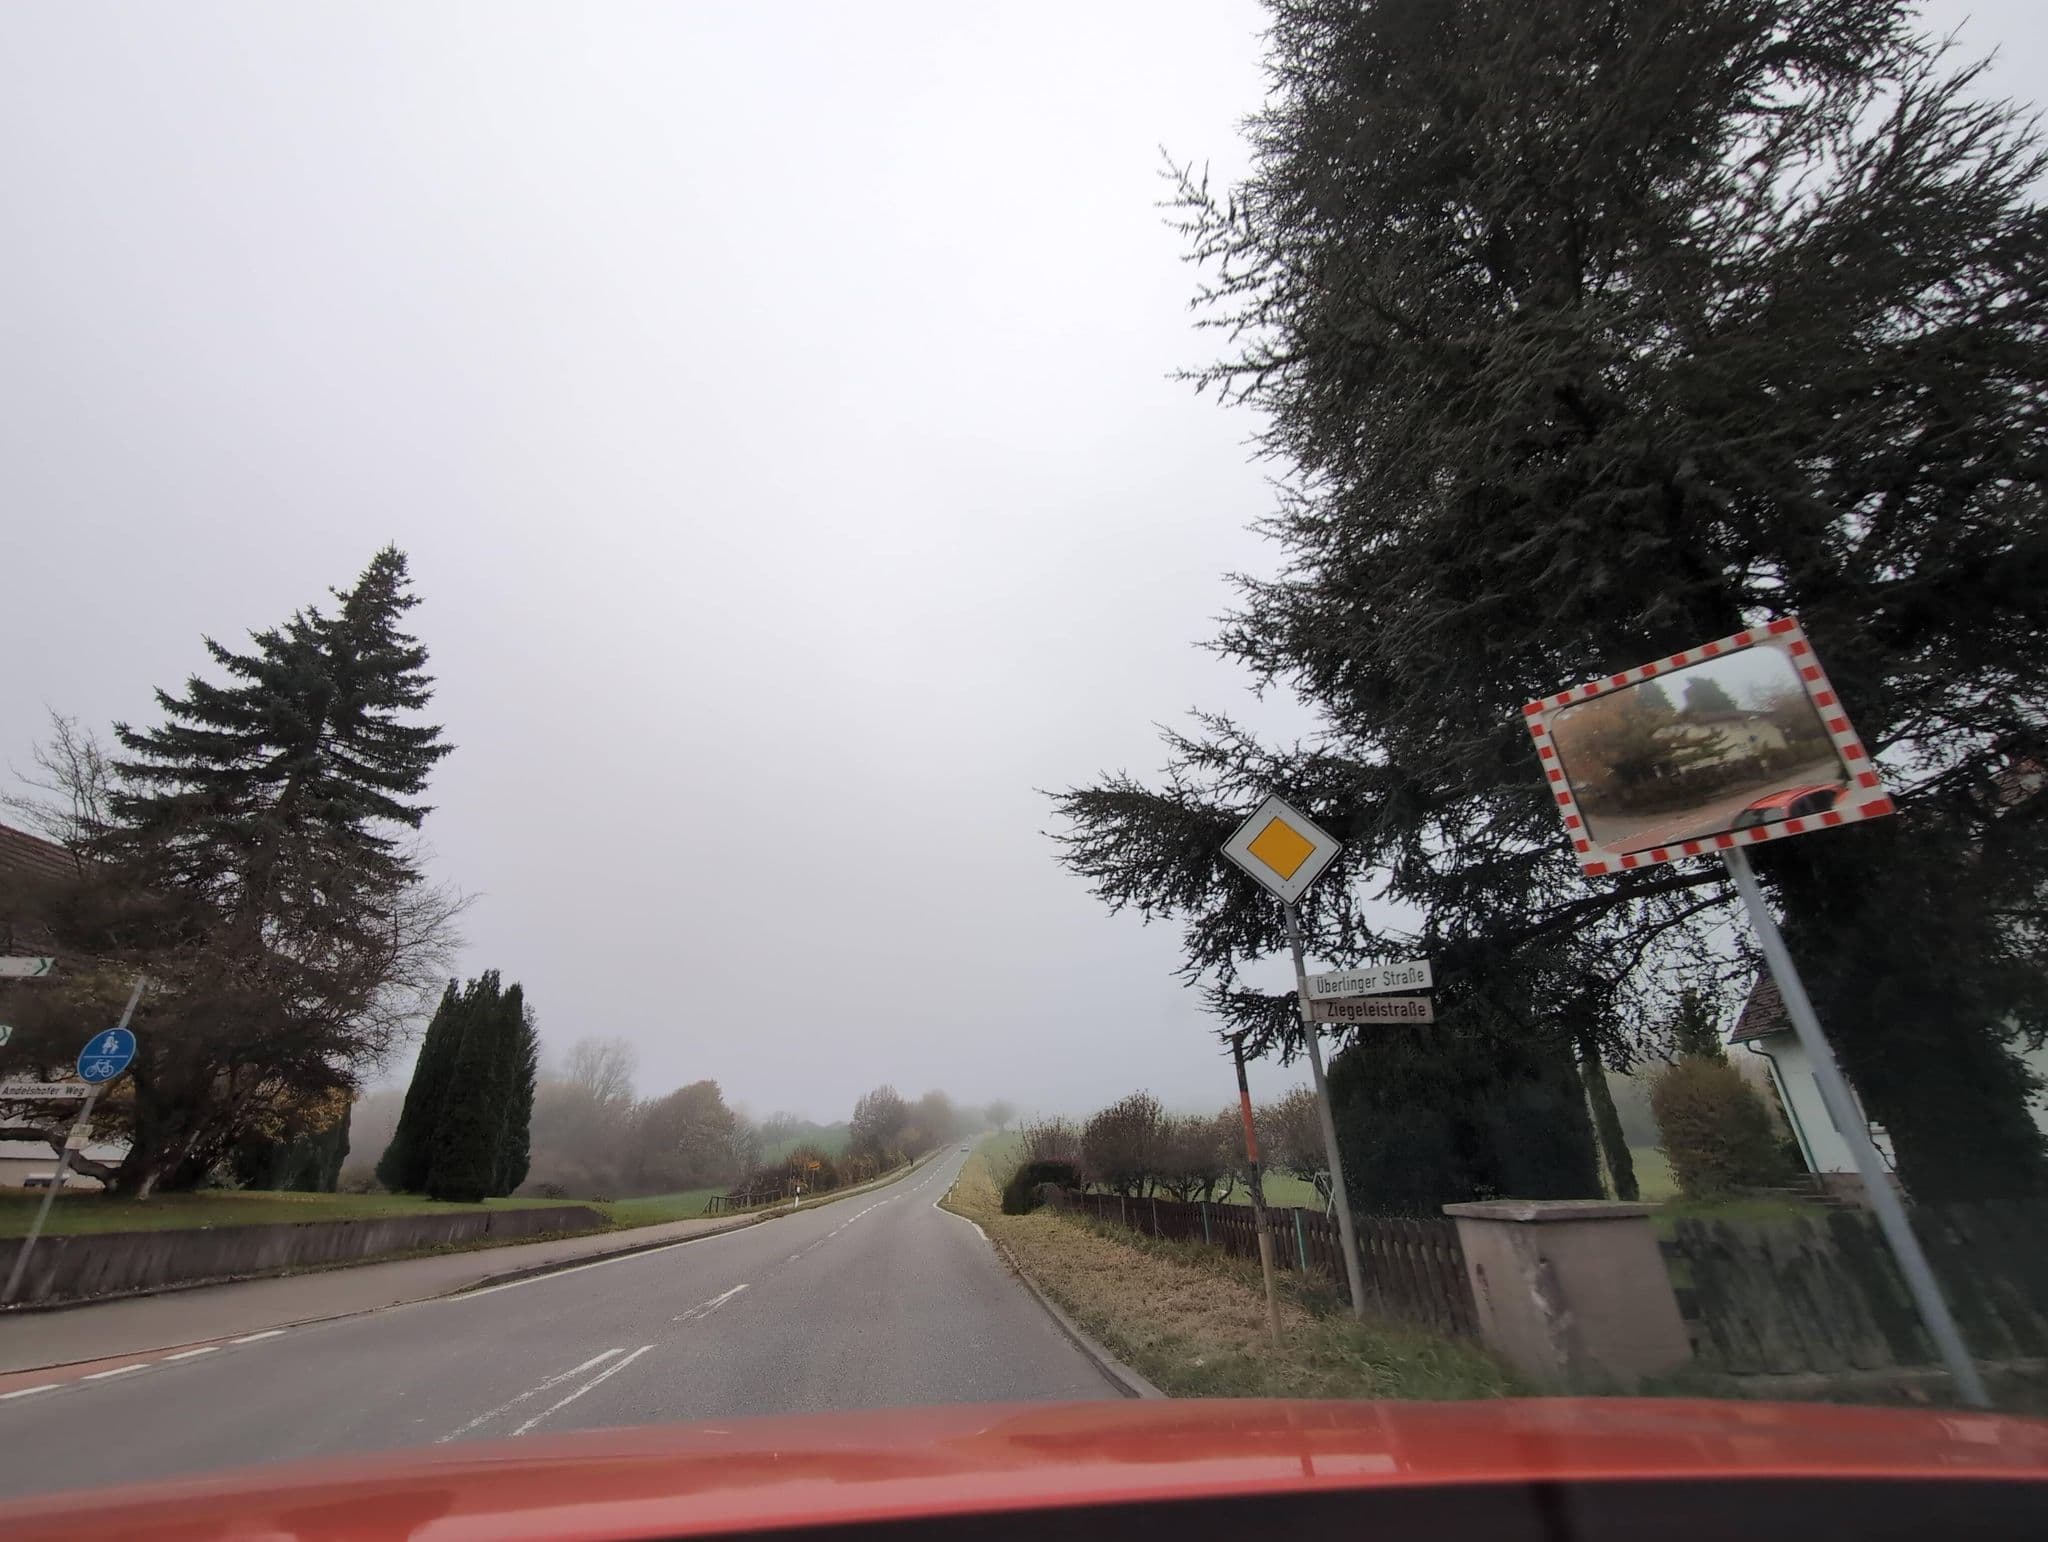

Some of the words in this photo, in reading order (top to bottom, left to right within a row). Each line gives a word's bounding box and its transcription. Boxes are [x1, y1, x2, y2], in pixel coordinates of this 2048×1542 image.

[1316, 975, 1377, 994] Überlinger
[1382, 967, 1424, 987] Straße
[1327, 1001, 1427, 1020] Ziegeleistraße
[1, 1085, 61, 1096] Andelshofer
[65, 1085, 86, 1097] Weg
